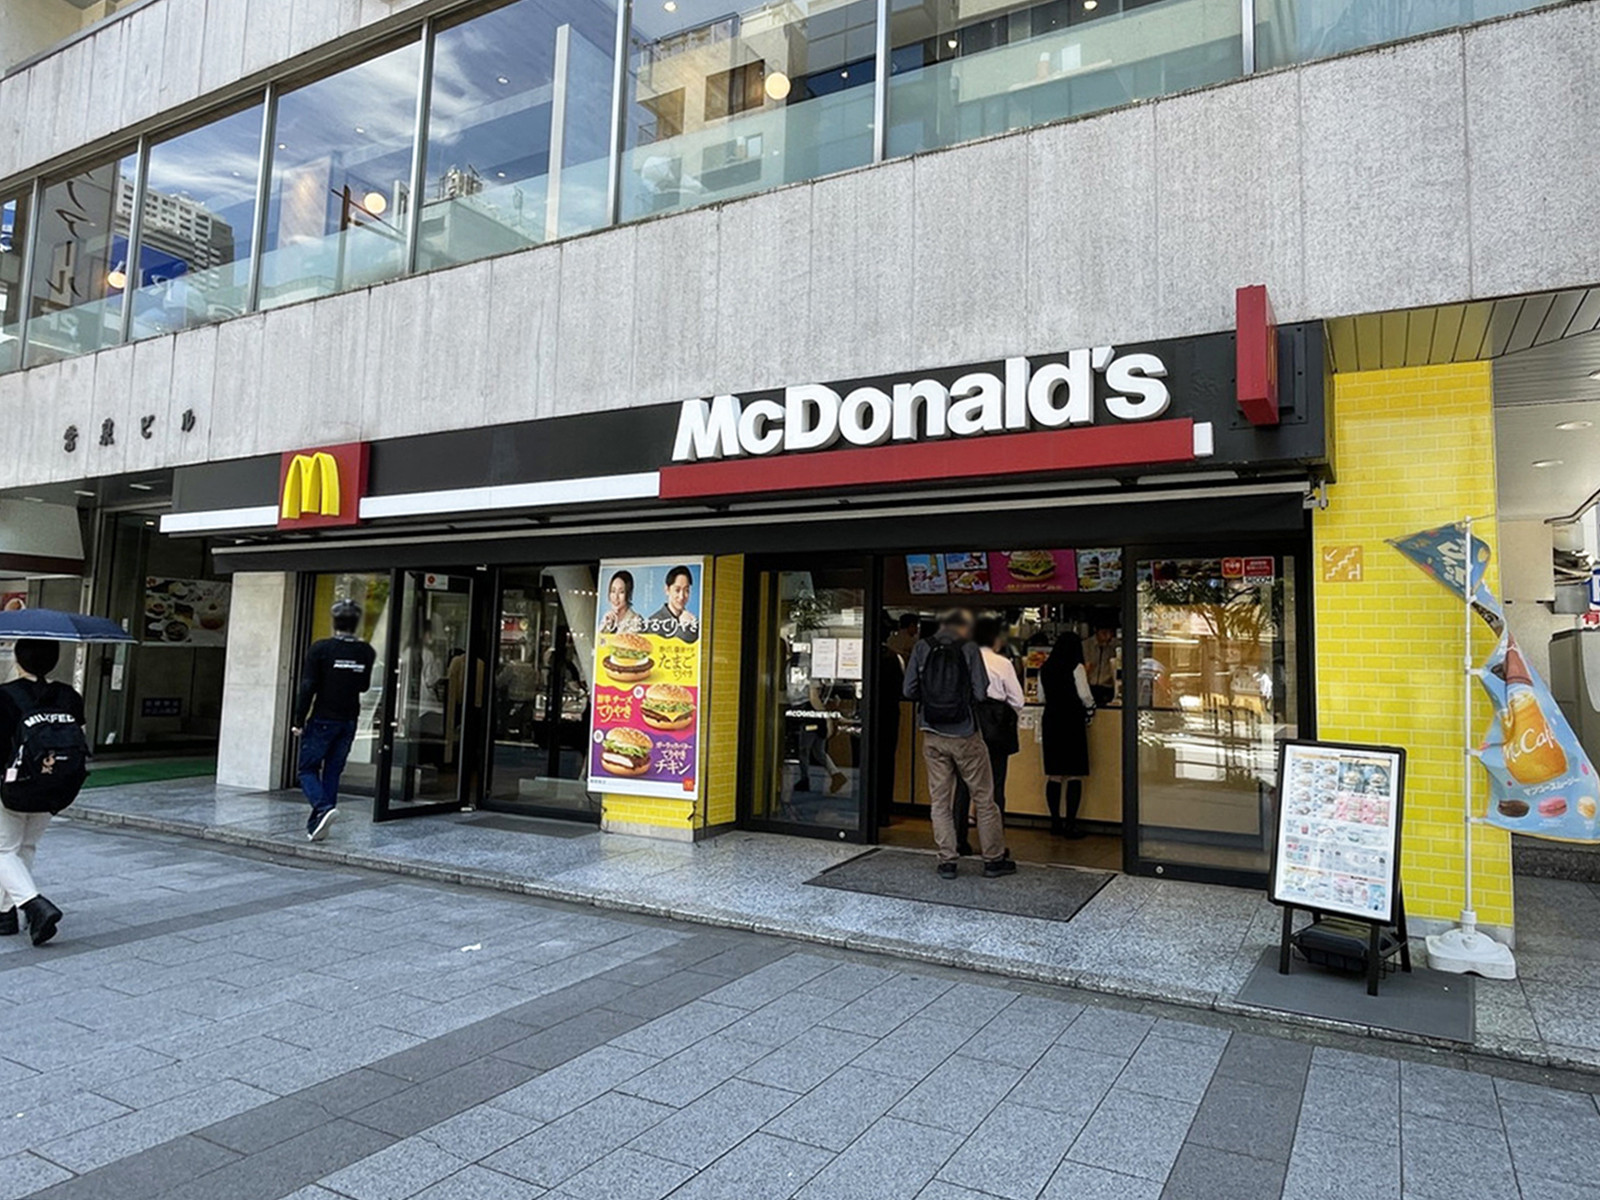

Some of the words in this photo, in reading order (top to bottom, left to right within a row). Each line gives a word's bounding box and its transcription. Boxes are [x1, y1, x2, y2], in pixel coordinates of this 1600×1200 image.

[672, 346, 1171, 461] McDonald's
[658, 653, 695, 670] たまご
[654, 759, 691, 775] チキン
